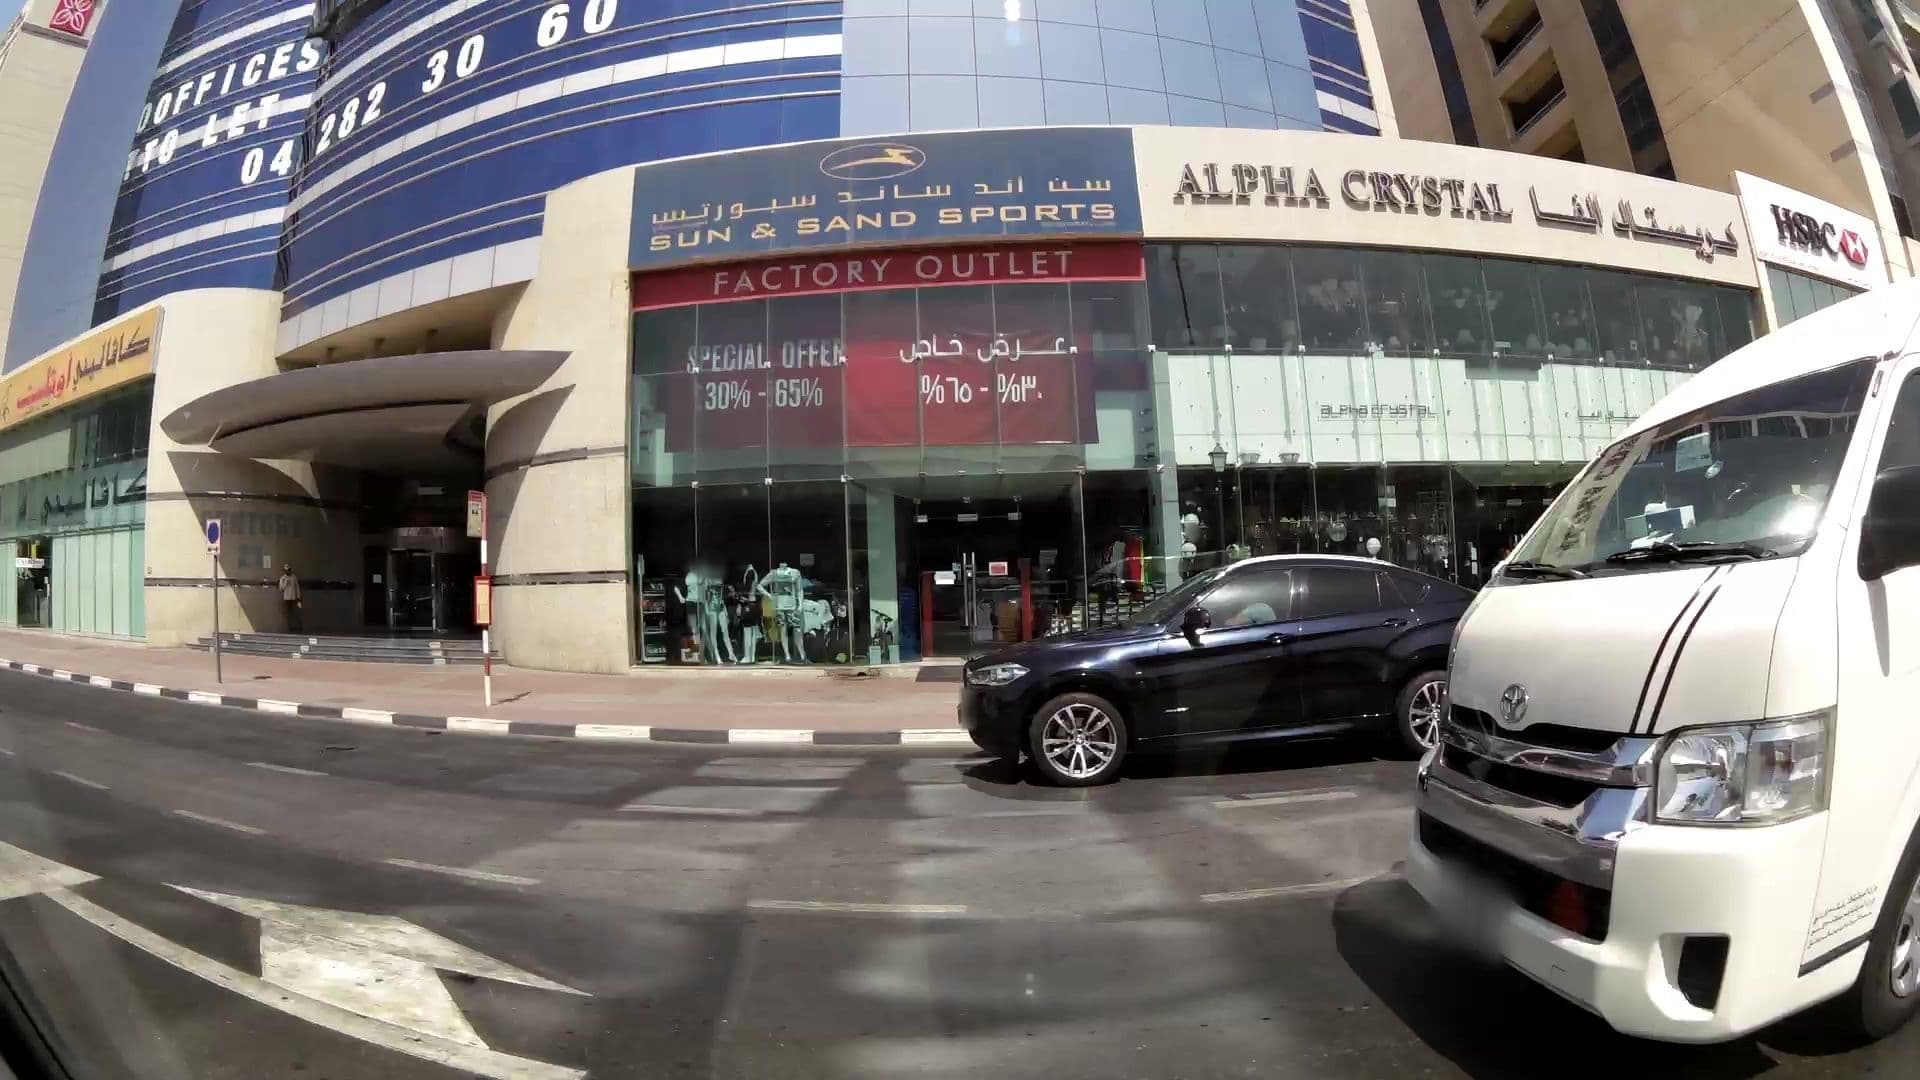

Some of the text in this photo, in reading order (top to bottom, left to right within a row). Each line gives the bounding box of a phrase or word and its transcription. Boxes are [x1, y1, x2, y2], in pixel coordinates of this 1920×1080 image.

[153, 37, 323, 125] OFFICES
[241, 0, 617, 185] 04 282 30 60
[142, 94, 280, 172] TO LET
[1173, 162, 1514, 220] ALPHA CRYSTAL
[650, 203, 1115, 251] SUN & SAND SPORTS
[1770, 203, 1839, 260] HSBC
[713, 250, 1073, 296] FACTORY OUTLET
[686, 338, 845, 374] SPECIAL OFFER
[705, 379, 751, 411] 30%
[775, 377, 823, 408] 65%
